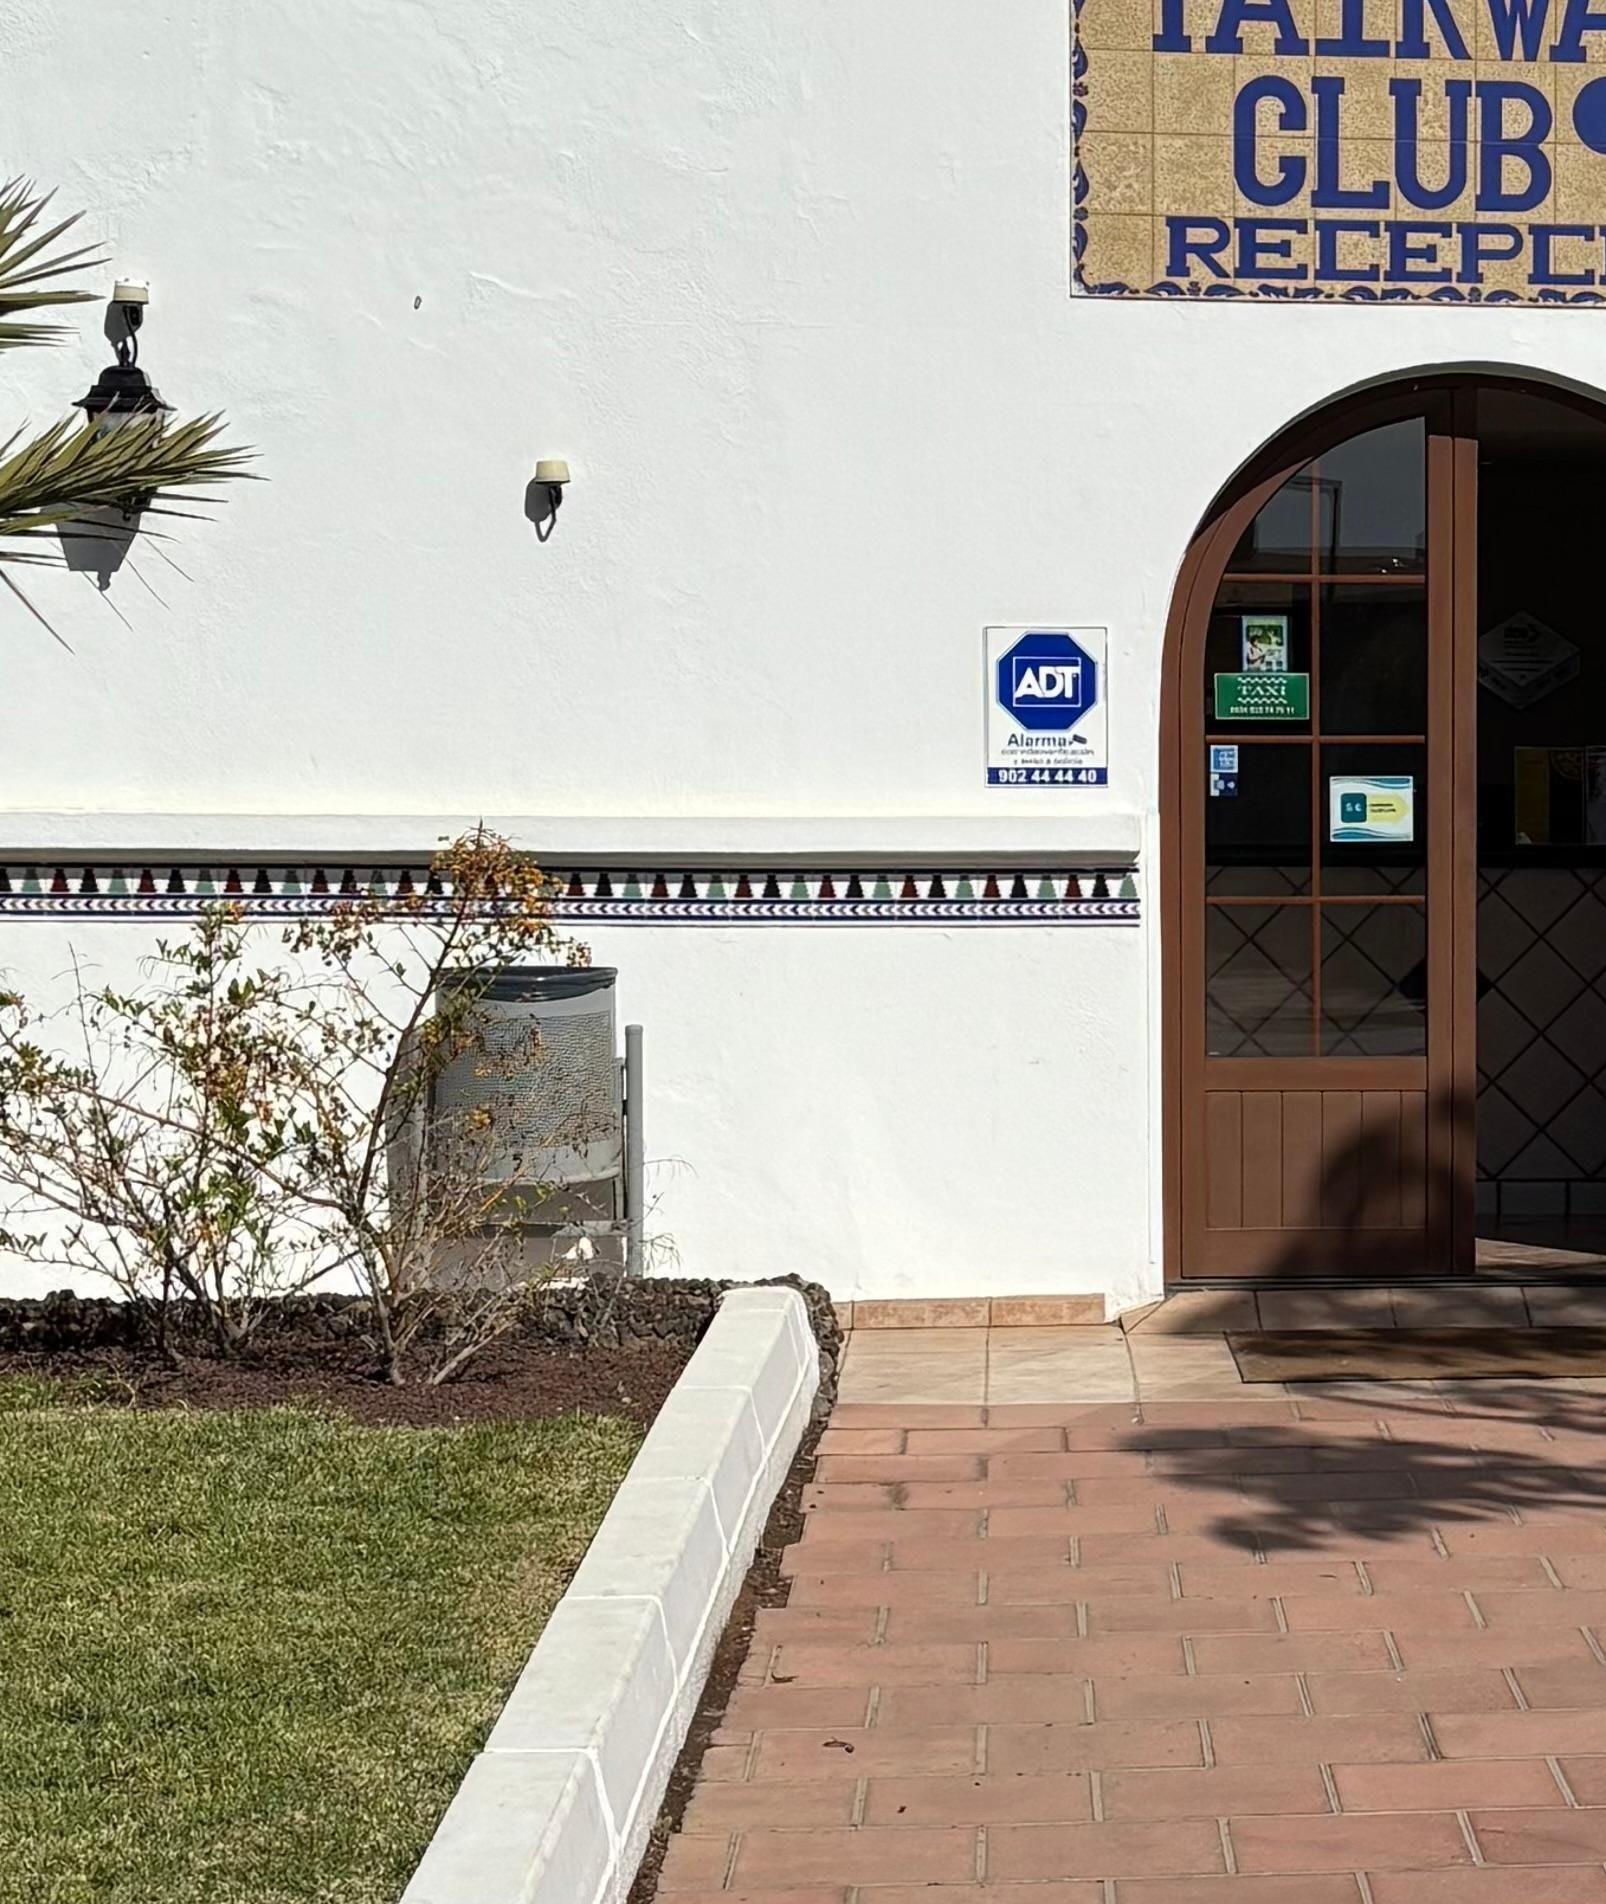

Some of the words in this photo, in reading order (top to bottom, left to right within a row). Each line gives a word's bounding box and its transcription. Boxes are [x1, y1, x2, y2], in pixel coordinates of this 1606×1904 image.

[1233, 75, 1554, 213] CLUB
[1014, 666, 1081, 698] ADT
[1237, 685, 1286, 696] TAXI
[1008, 733, 1067, 747] Alarma
[998, 769, 1027, 783] 902
[1031, 769, 1050, 782] 44
[1055, 769, 1073, 782] 44
[1078, 769, 1097, 783] 40
